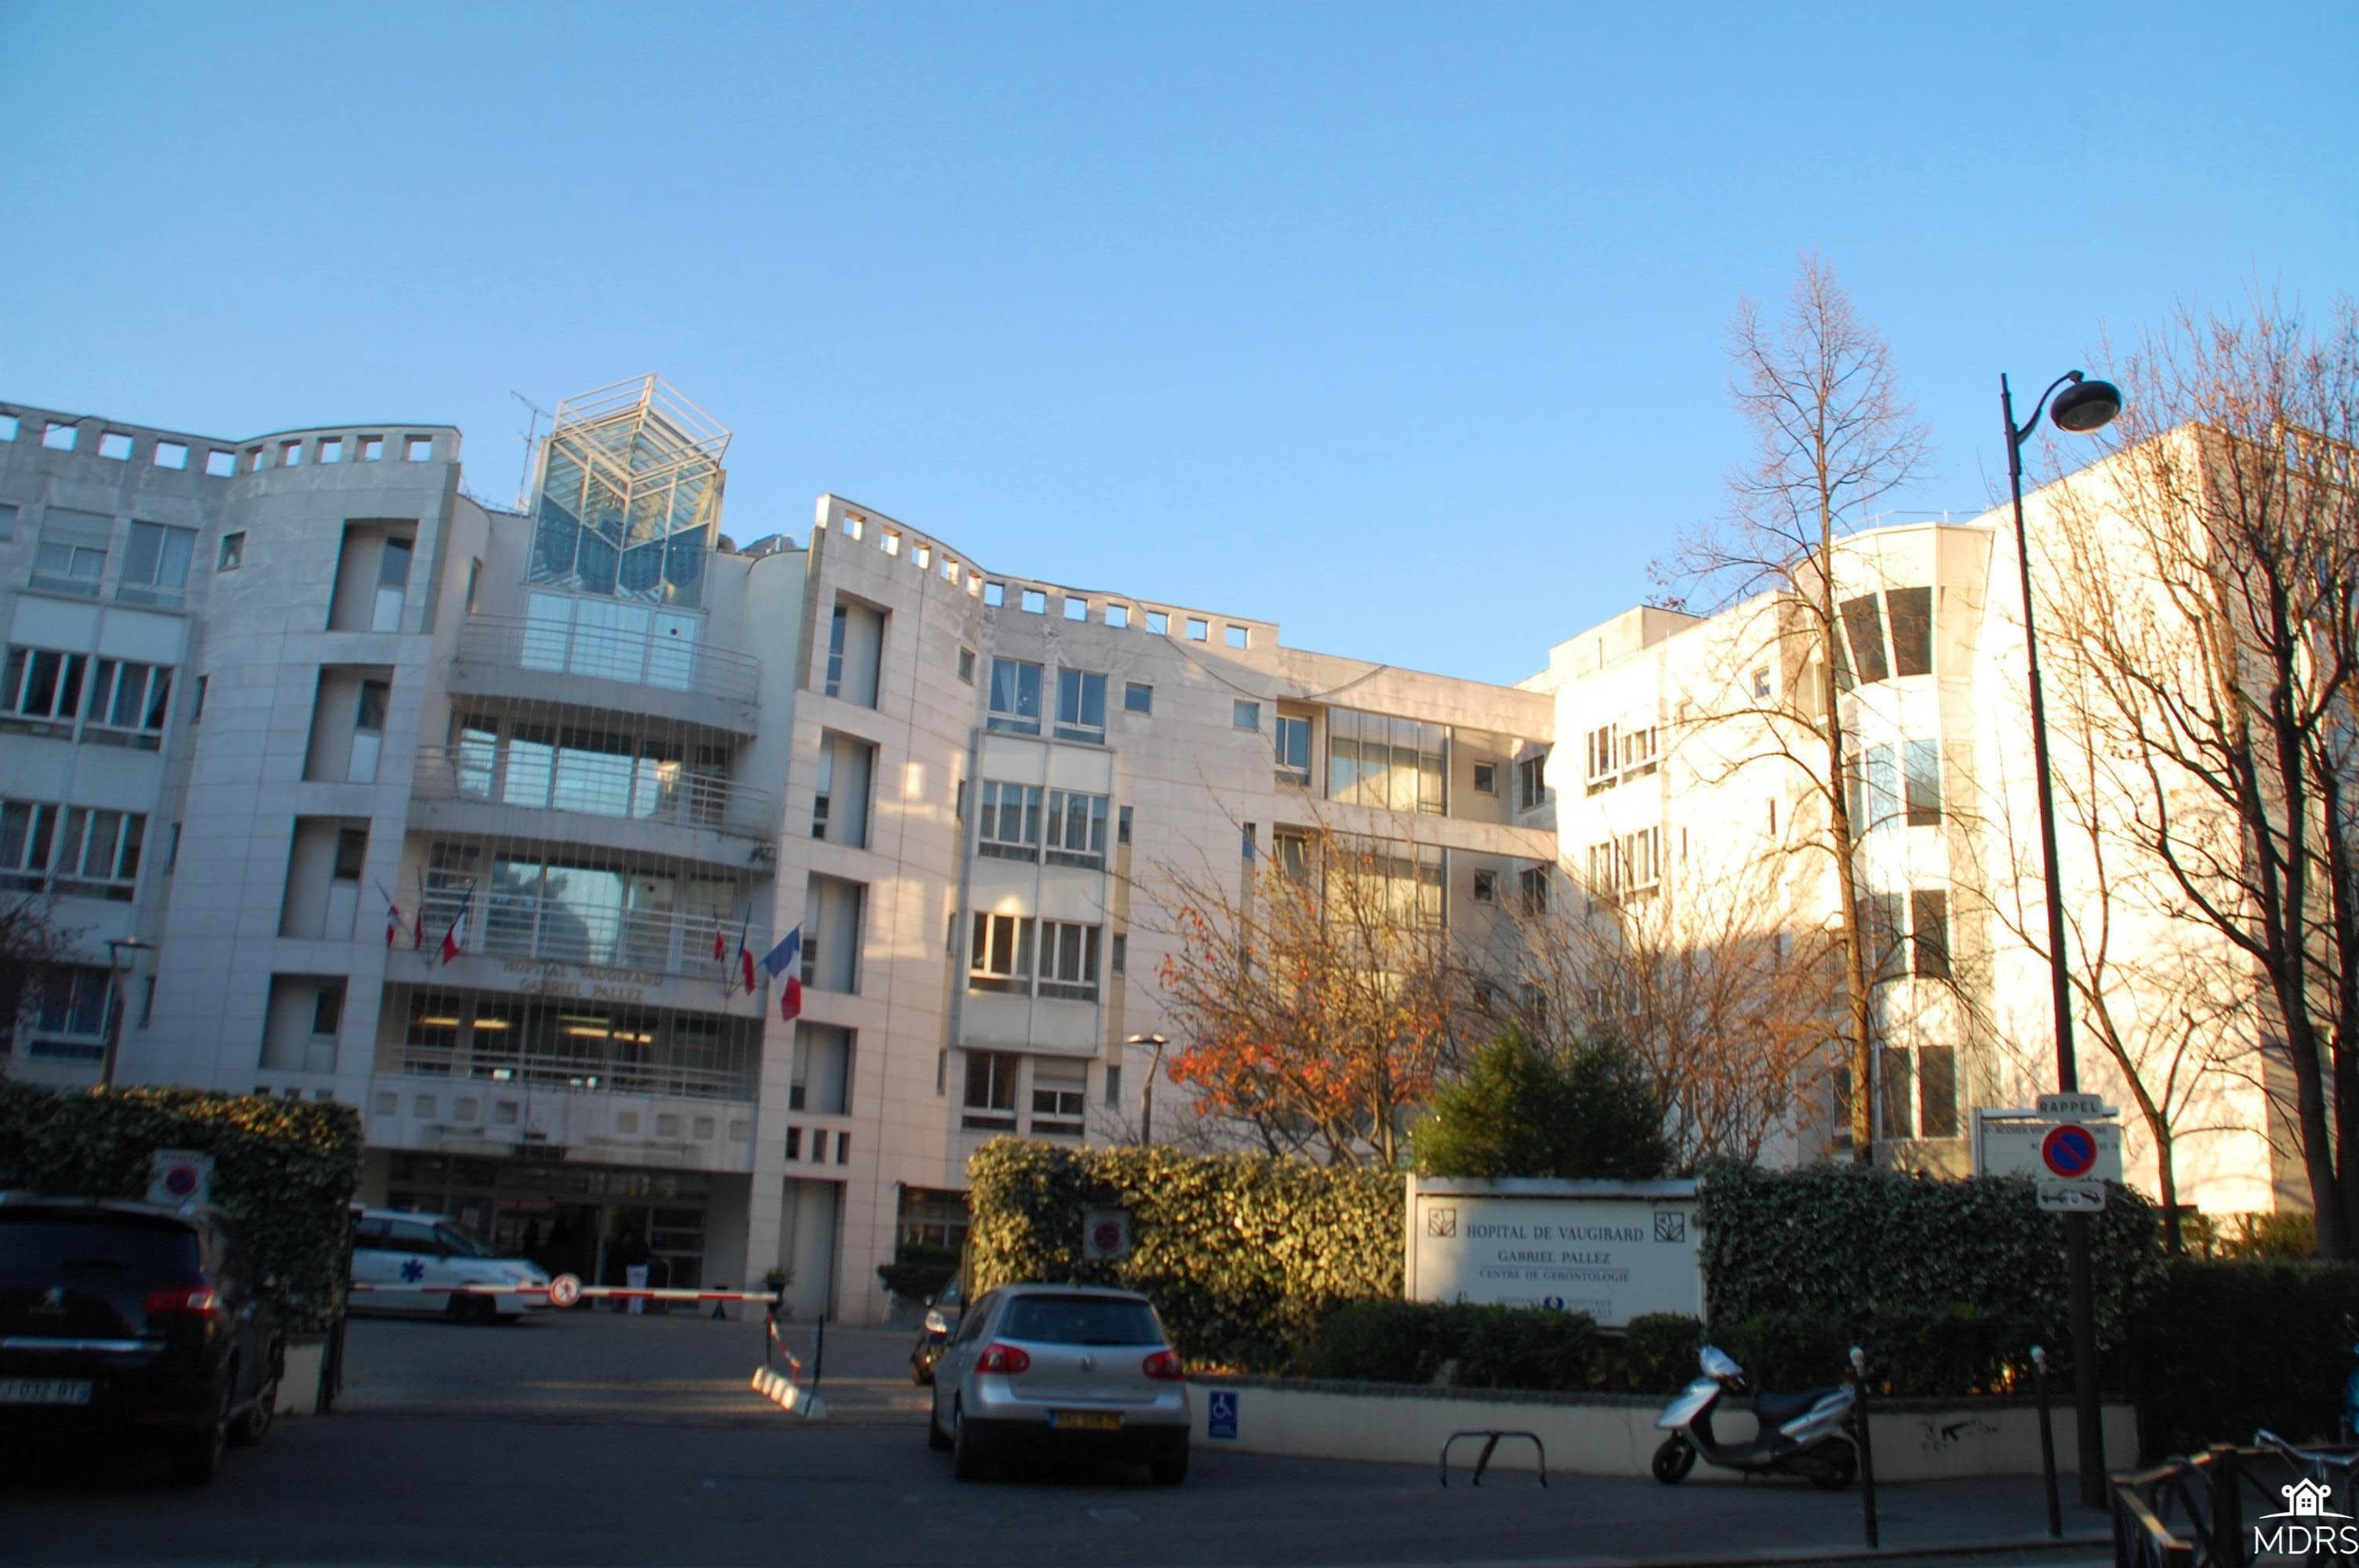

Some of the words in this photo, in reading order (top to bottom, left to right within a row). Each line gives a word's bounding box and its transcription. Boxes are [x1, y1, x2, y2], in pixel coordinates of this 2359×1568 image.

[2039, 1100, 2099, 1114] RAPPEL
[1467, 1225, 1527, 1240] HOPITAL
[1533, 1225, 1552, 1240] DE
[1558, 1225, 1645, 1242] VAUGIRARD
[1497, 1250, 1555, 1263] GABRIEL
[1561, 1251, 1611, 1265] PALLEZ
[1479, 1269, 1520, 1281] CENTRE
[1525, 1270, 1538, 1281] DE
[1543, 1271, 1630, 1283] GERONTOLOGIE
